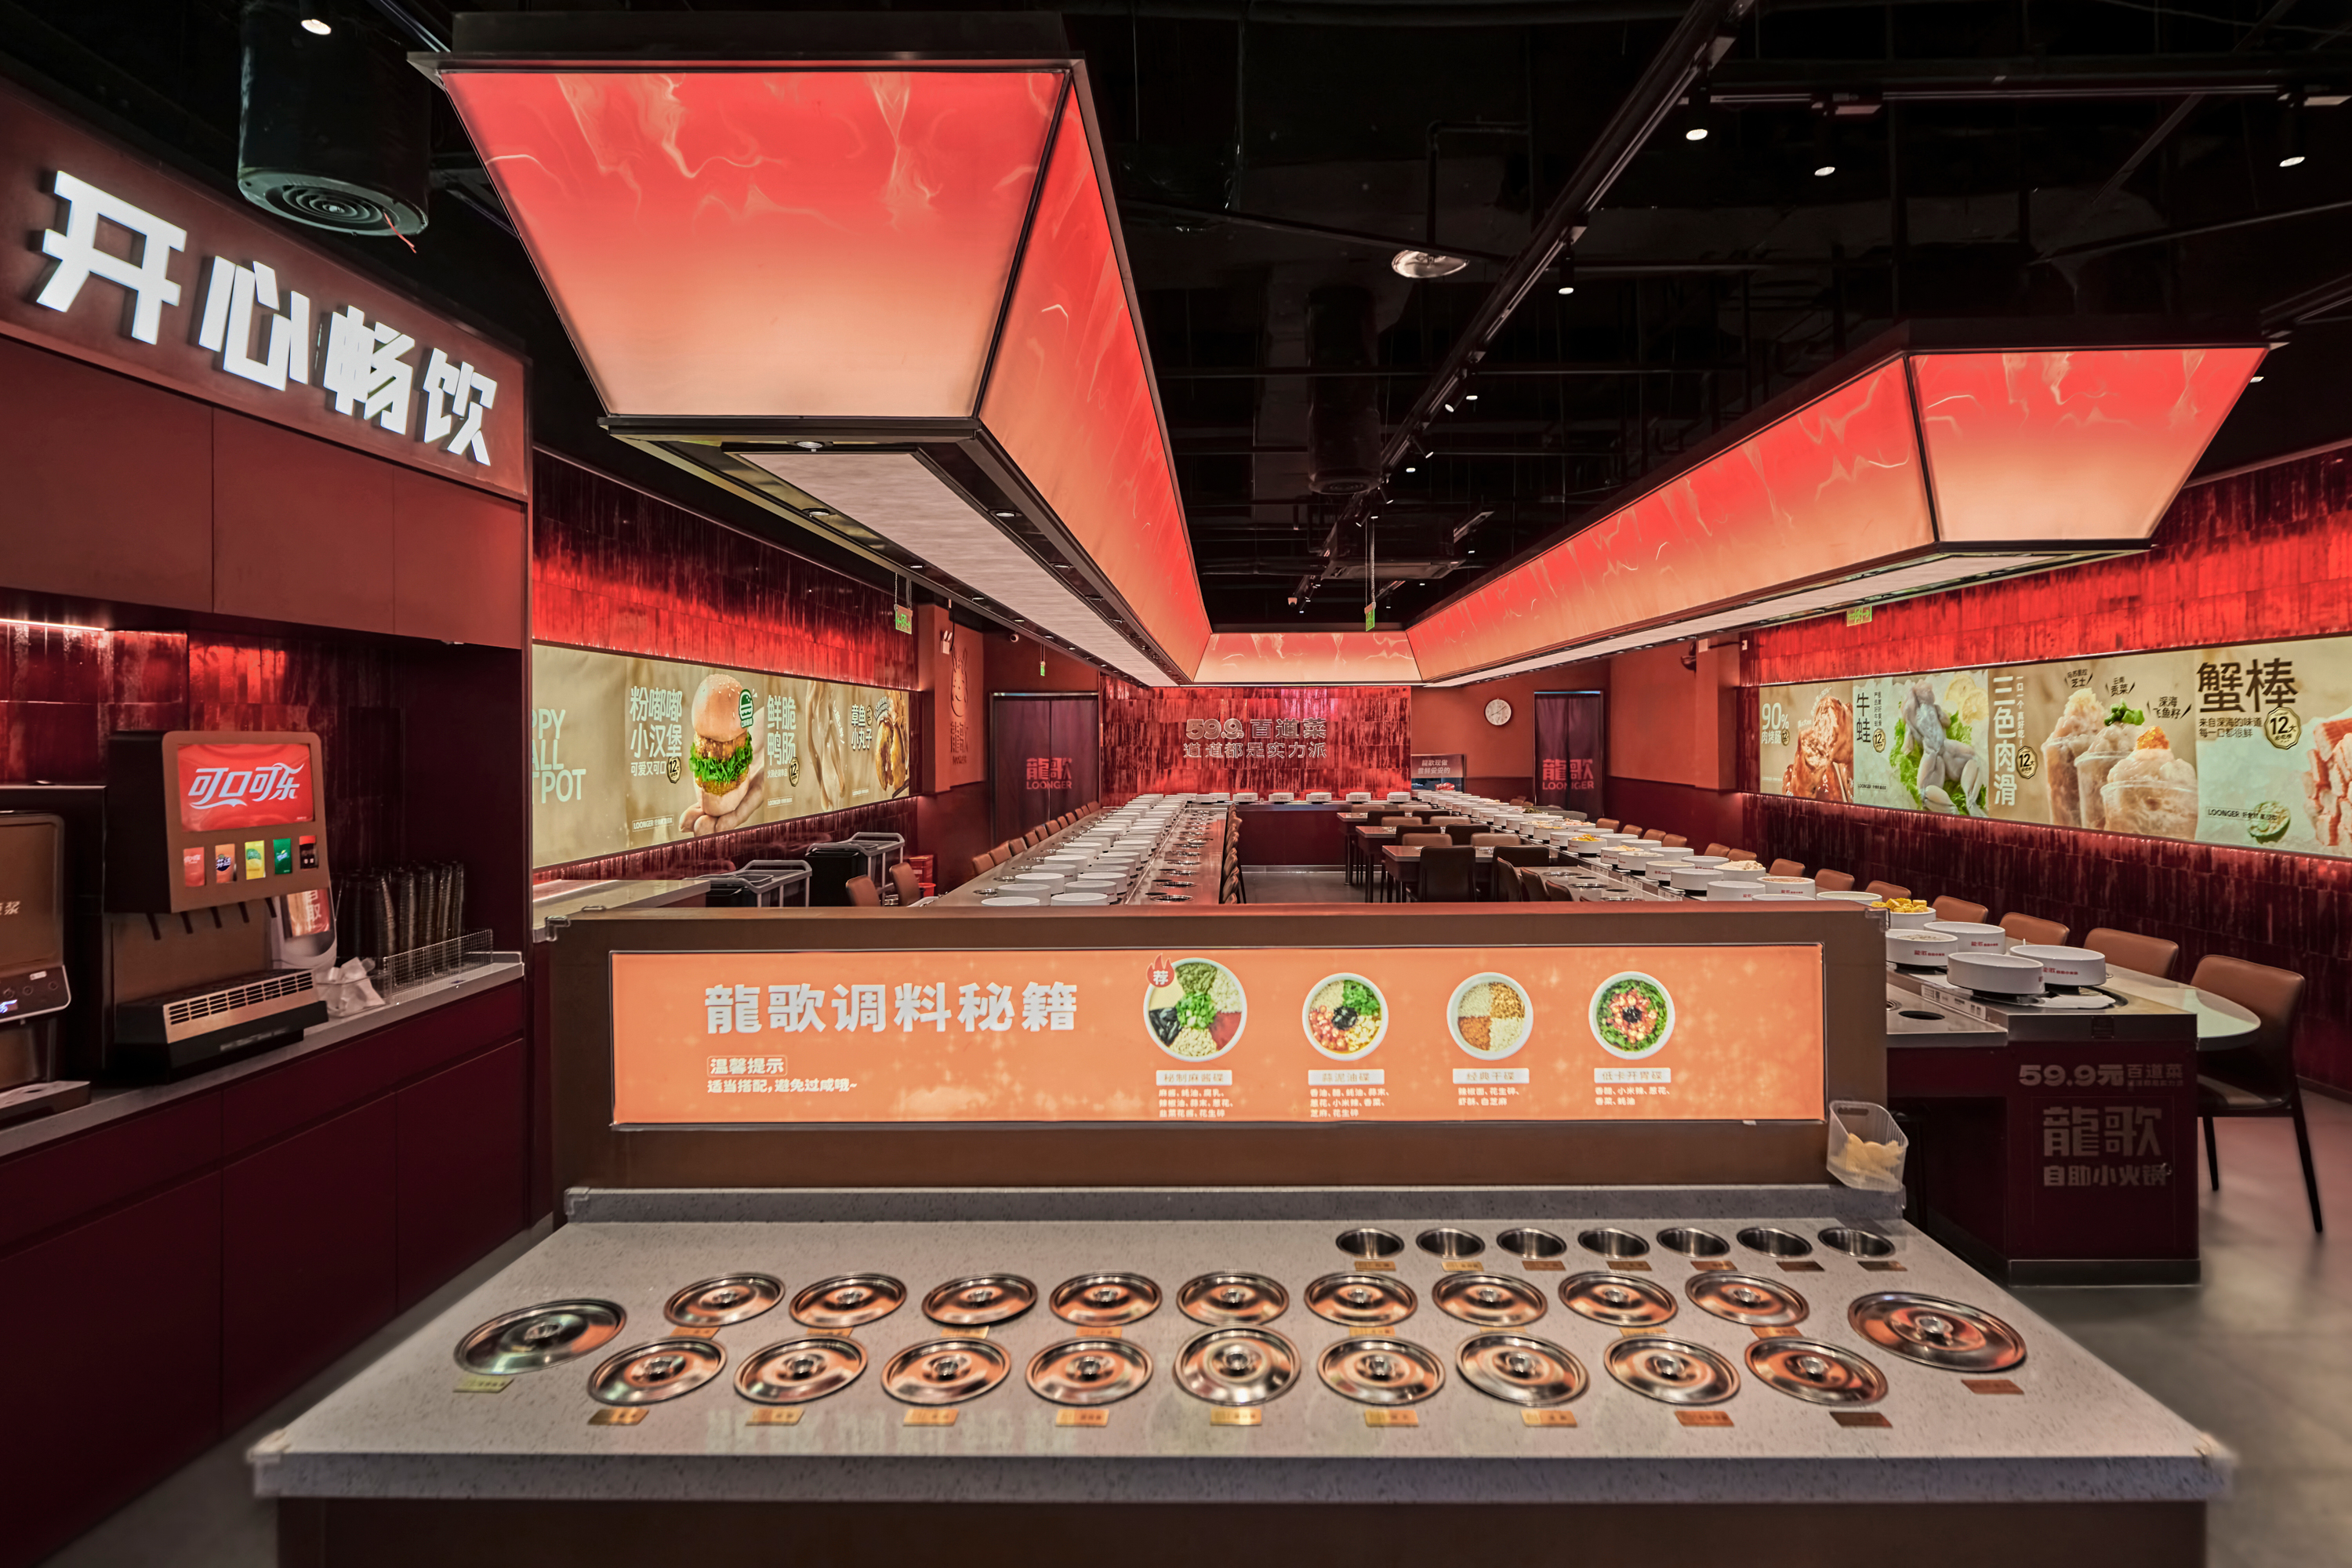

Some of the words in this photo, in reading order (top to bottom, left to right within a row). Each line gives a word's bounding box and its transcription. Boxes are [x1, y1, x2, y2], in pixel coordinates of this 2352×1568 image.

[37, 170, 498, 466] 开心畅饮
[2071, 678, 2086, 688] 芝士
[2196, 658, 2299, 713] 蟹棒
[630, 686, 683, 722] 粉嘟嘟
[2158, 696, 2178, 707] 深海
[767, 695, 796, 730] 鲜脆
[851, 704, 866, 727] 章鱼
[1762, 702, 1789, 730] 90%
[1857, 692, 1871, 742] 牛蛙
[2153, 707, 2181, 720] 飞鱼籽
[2199, 717, 2263, 728] 来自深海的味道
[1250, 717, 1327, 739] 百道菜
[1761, 730, 1781, 744] 肉烤肠
[2199, 728, 2253, 738] 每一口都很鲜
[630, 723, 682, 758] 小汉堡
[767, 731, 796, 766] 鸭肠
[851, 728, 873, 750] 小丸子
[1993, 676, 2017, 806] 三色肉滑
[1183, 742, 1327, 759] 道道都是实力派
[630, 761, 666, 777] 可爱又可口
[1026, 757, 1073, 780] 龍歌
[1542, 759, 1594, 780] 龍歌
[188, 763, 305, 810] 可口可乐
[1026, 781, 1073, 789] LOONGER
[2208, 809, 2240, 818] LOONGER
[0, 901, 21, 916] 浆
[1153, 971, 1169, 985] 荐
[704, 982, 1078, 1034] 龍歌调料秘籍
[710, 1058, 784, 1074] 温馨提示
[1466, 1072, 1515, 1081] 经典干碟
[1602, 1071, 1663, 1080] 低卡开胃碟
[2019, 1064, 2125, 1087] 59.9元
[2125, 1063, 2183, 1079] 百道菜
[1164, 1073, 1224, 1083] 秘制麻酱碟
[1322, 1073, 1370, 1083] 蒜泥油碟
[2042, 1106, 2162, 1156] 龍歌
[2042, 1165, 2167, 1186] 自助小火锅
